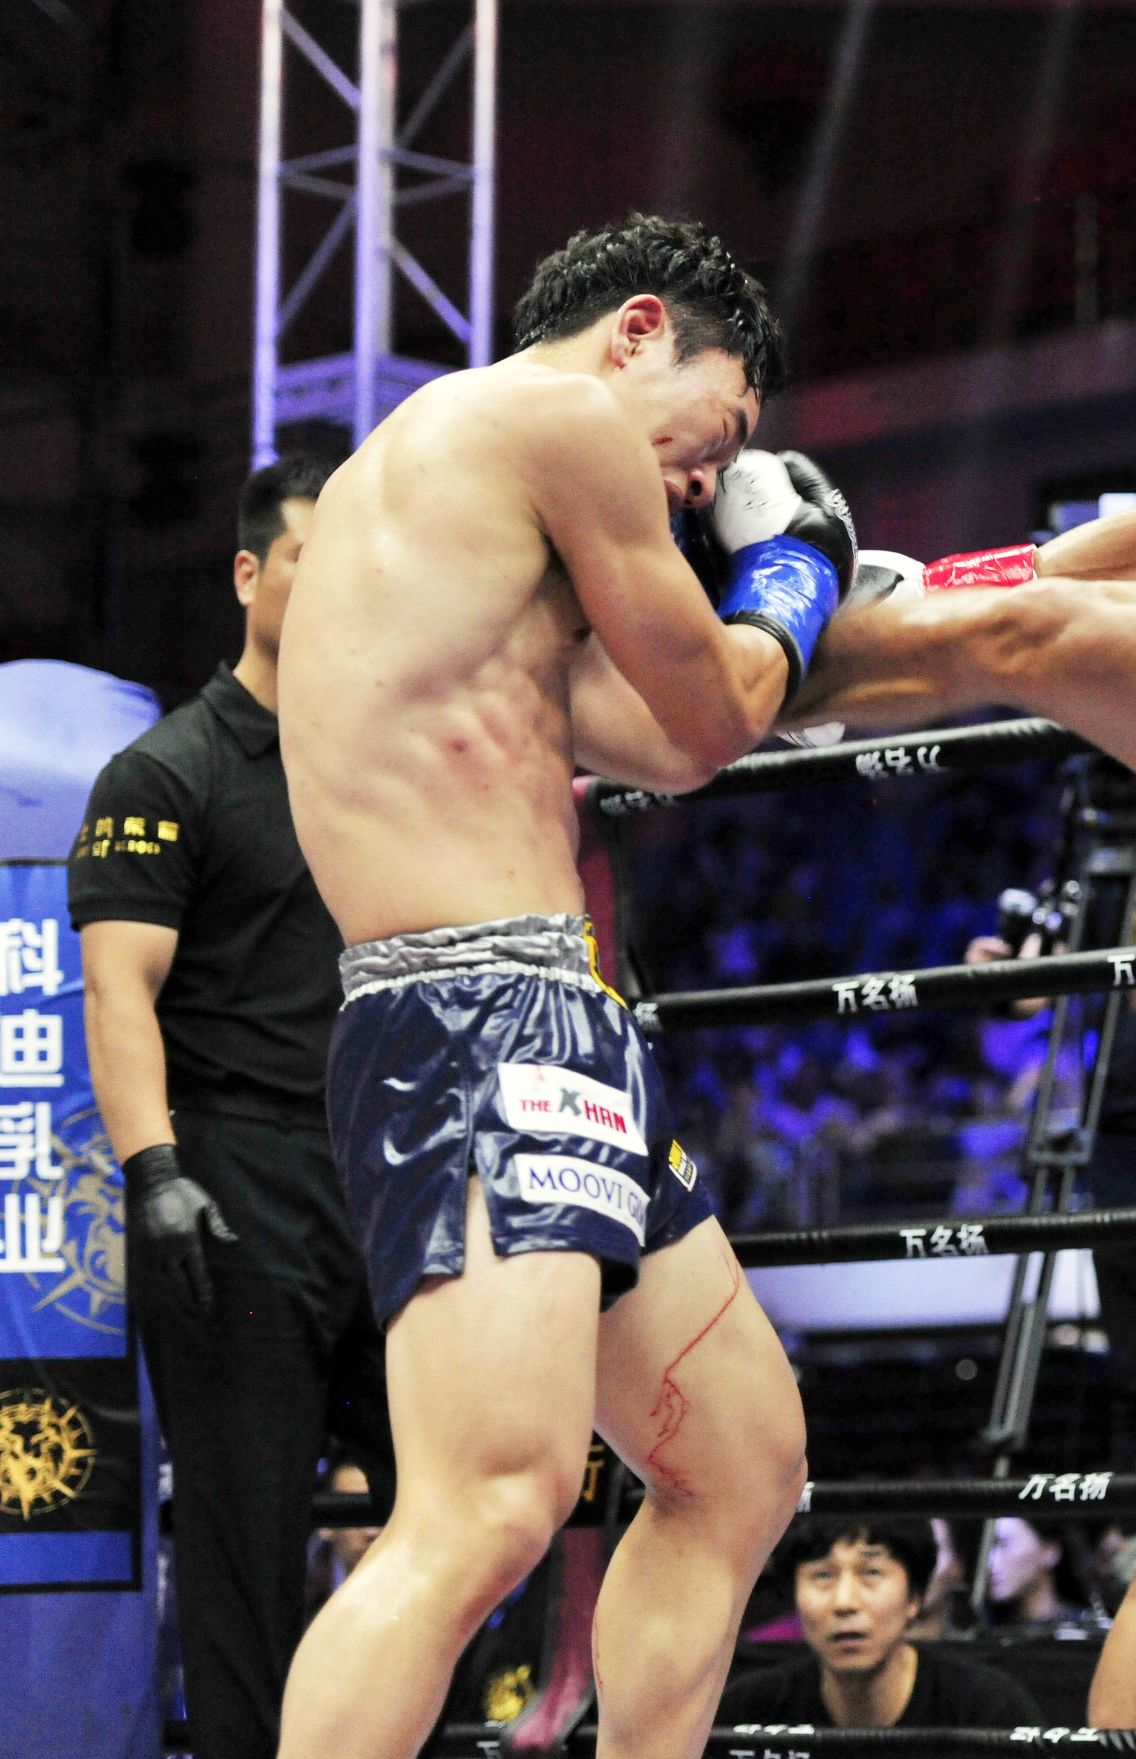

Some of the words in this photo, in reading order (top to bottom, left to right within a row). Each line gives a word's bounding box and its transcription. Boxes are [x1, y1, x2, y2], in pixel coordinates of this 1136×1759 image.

[832, 974, 918, 1014] 万名扬
[520, 1099, 552, 1113] THE
[558, 1087, 627, 1135] KHAN
[528, 1167, 622, 1209] MOOVI
[900, 1224, 989, 1258] 万名扬
[1018, 1472, 1115, 1502] 万名扬
